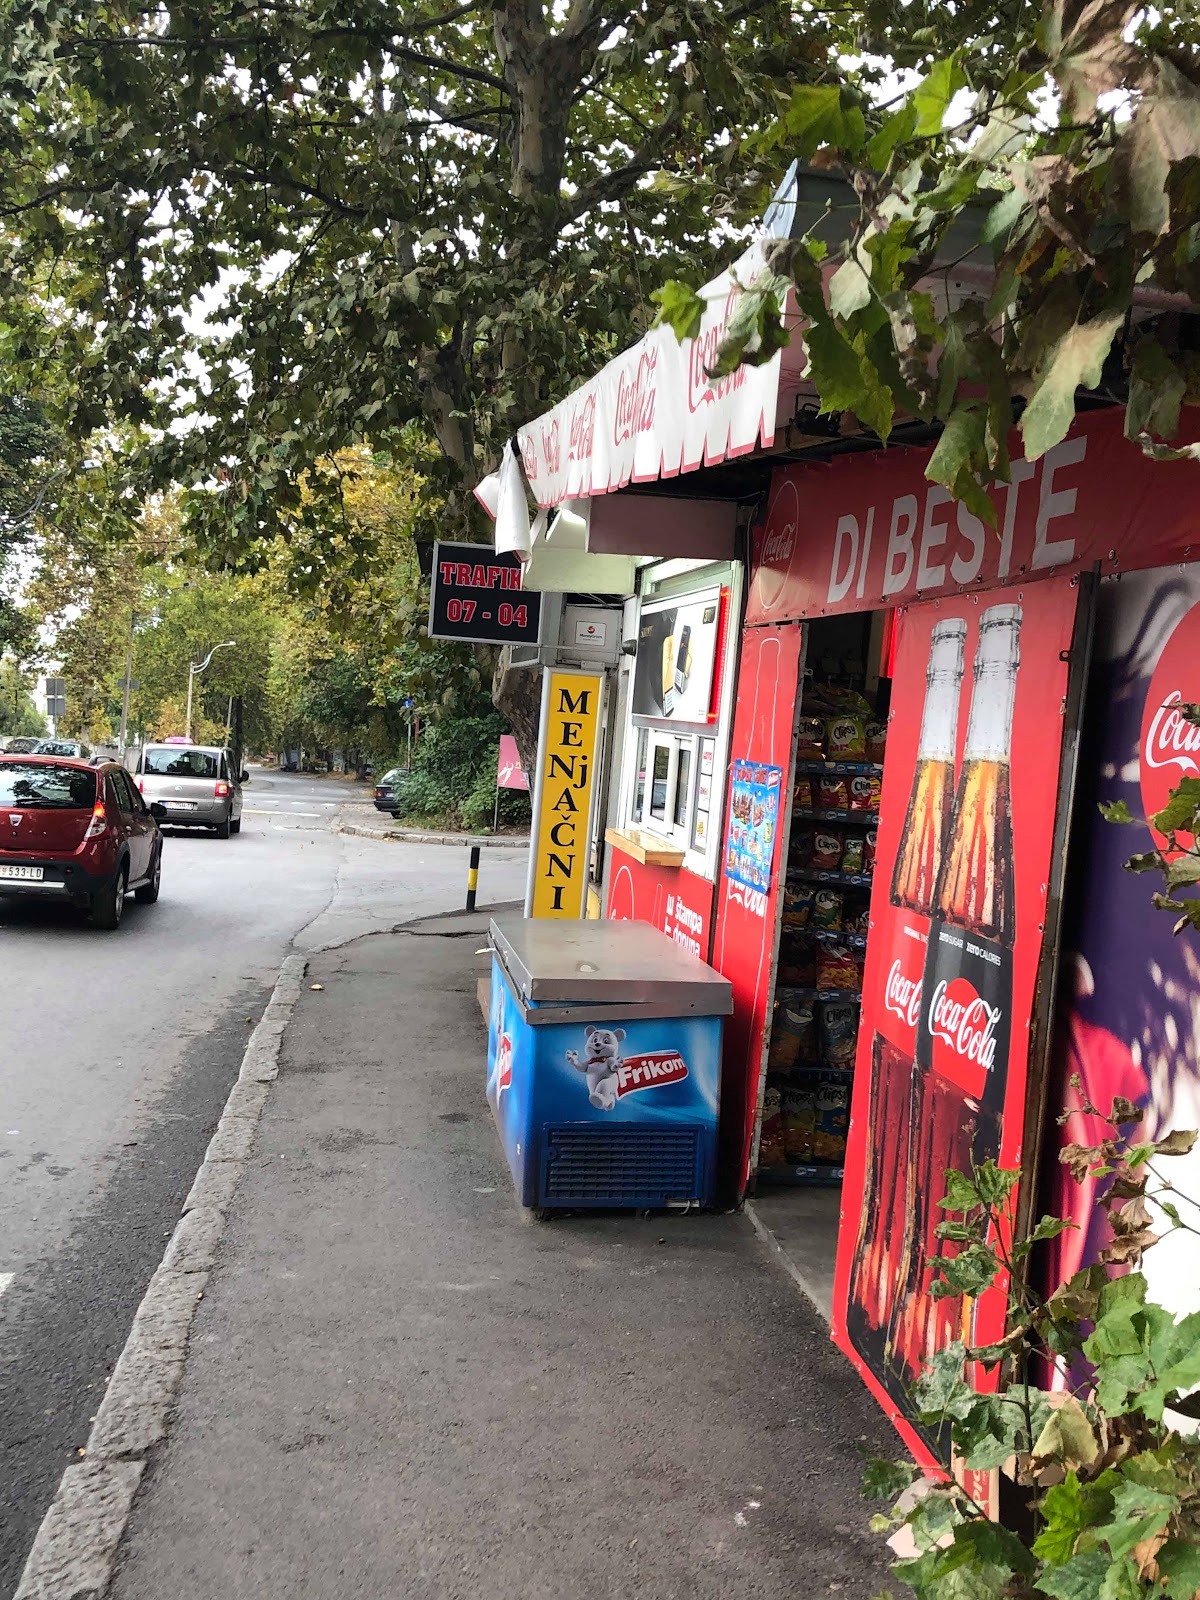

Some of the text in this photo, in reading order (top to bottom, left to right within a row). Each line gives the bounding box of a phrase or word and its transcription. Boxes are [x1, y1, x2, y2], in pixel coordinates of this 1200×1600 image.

[827, 435, 1087, 604] DI BESTE
[439, 561, 522, 592] TRAFIK
[446, 598, 482, 623] 07
[497, 602, 528, 628] 04
[833, 724, 856, 740] Clipsy
[545, 688, 592, 919] MENjAČNI
[8, 866, 42, 878] 533-LD
[675, 895, 703, 936] štampa
[885, 958, 923, 1027] Coca-C
[928, 979, 1003, 1070] Coca-Cola
[617, 1058, 686, 1089] Frikom
